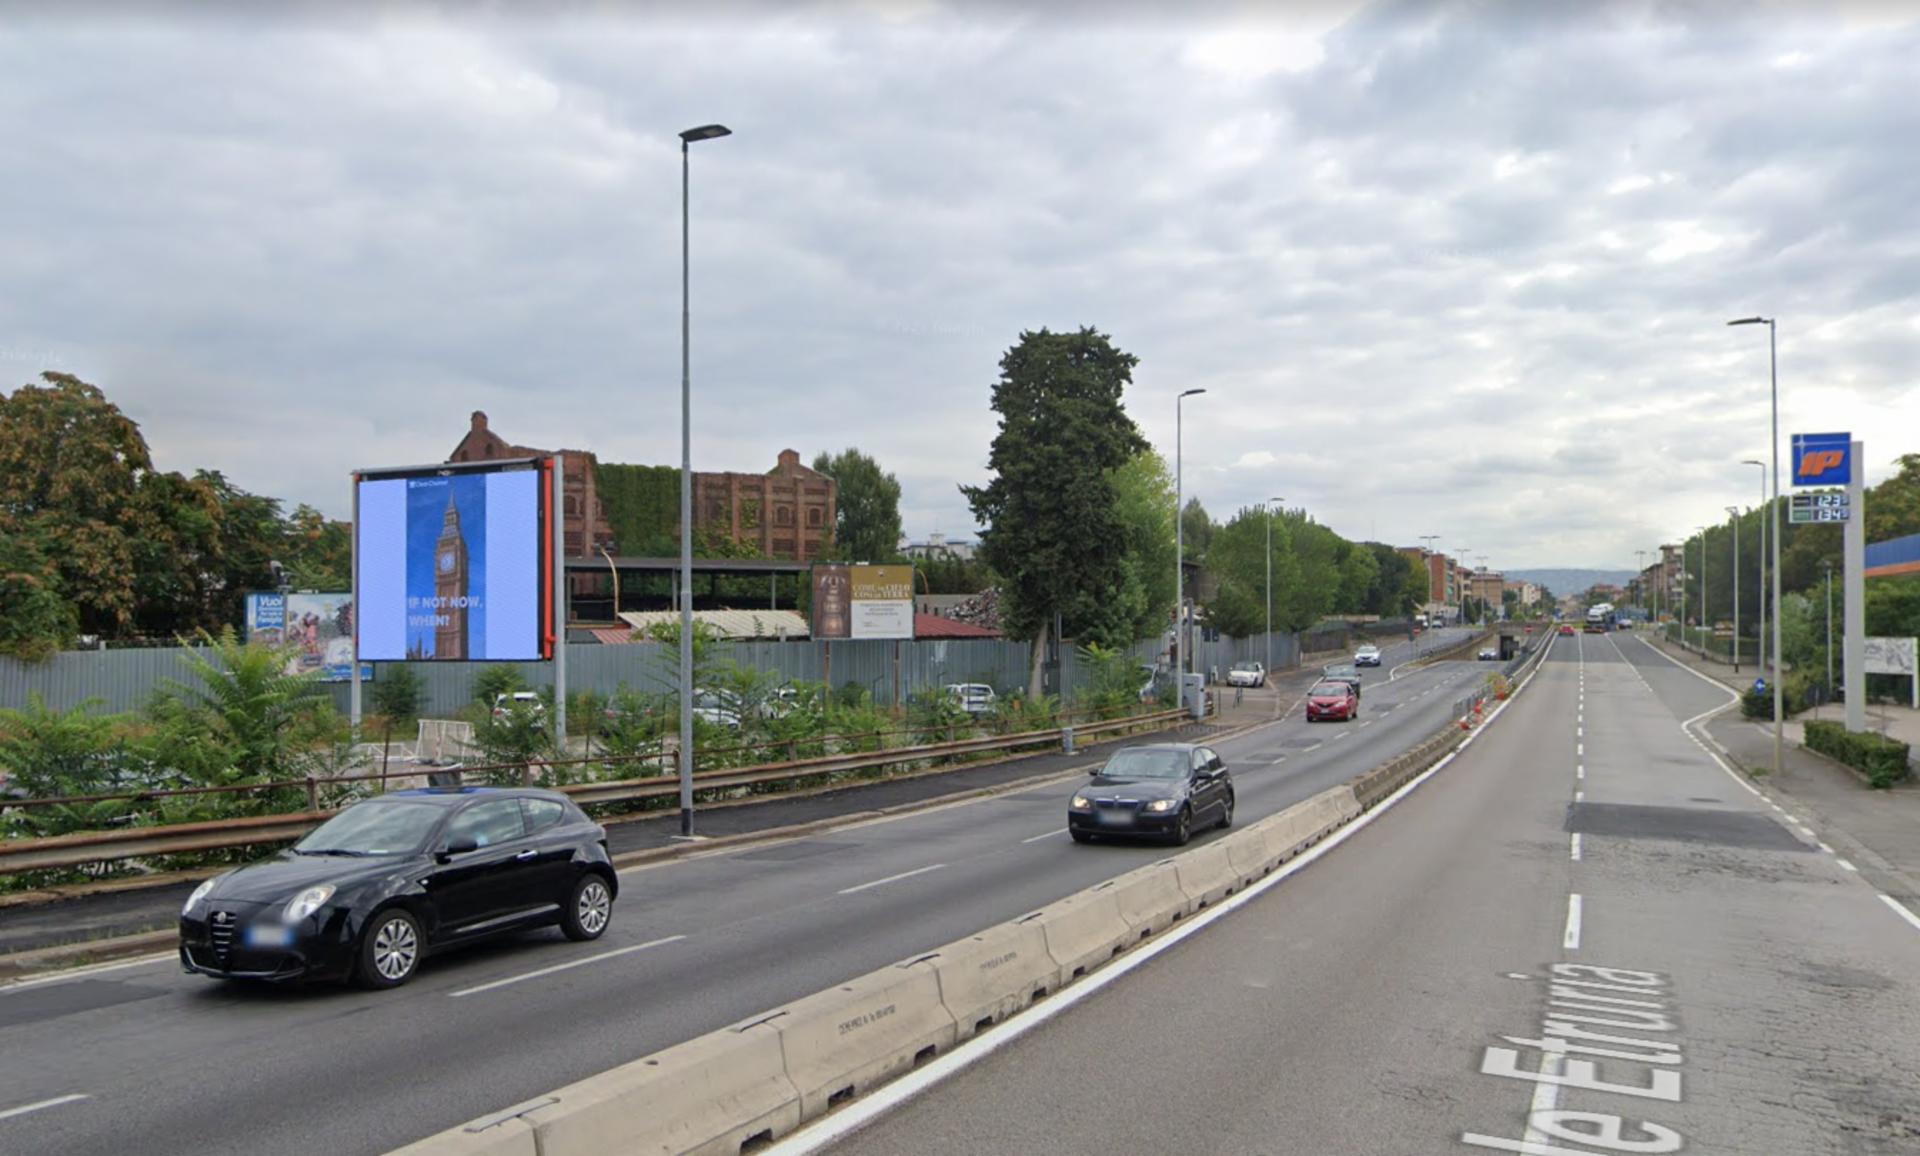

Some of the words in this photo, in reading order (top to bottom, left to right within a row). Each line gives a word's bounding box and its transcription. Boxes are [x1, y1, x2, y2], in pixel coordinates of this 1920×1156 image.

[408, 596, 420, 609] IF
[422, 596, 447, 609] NOT
[450, 596, 484, 609] NOW,
[408, 614, 450, 627] WHEN?
